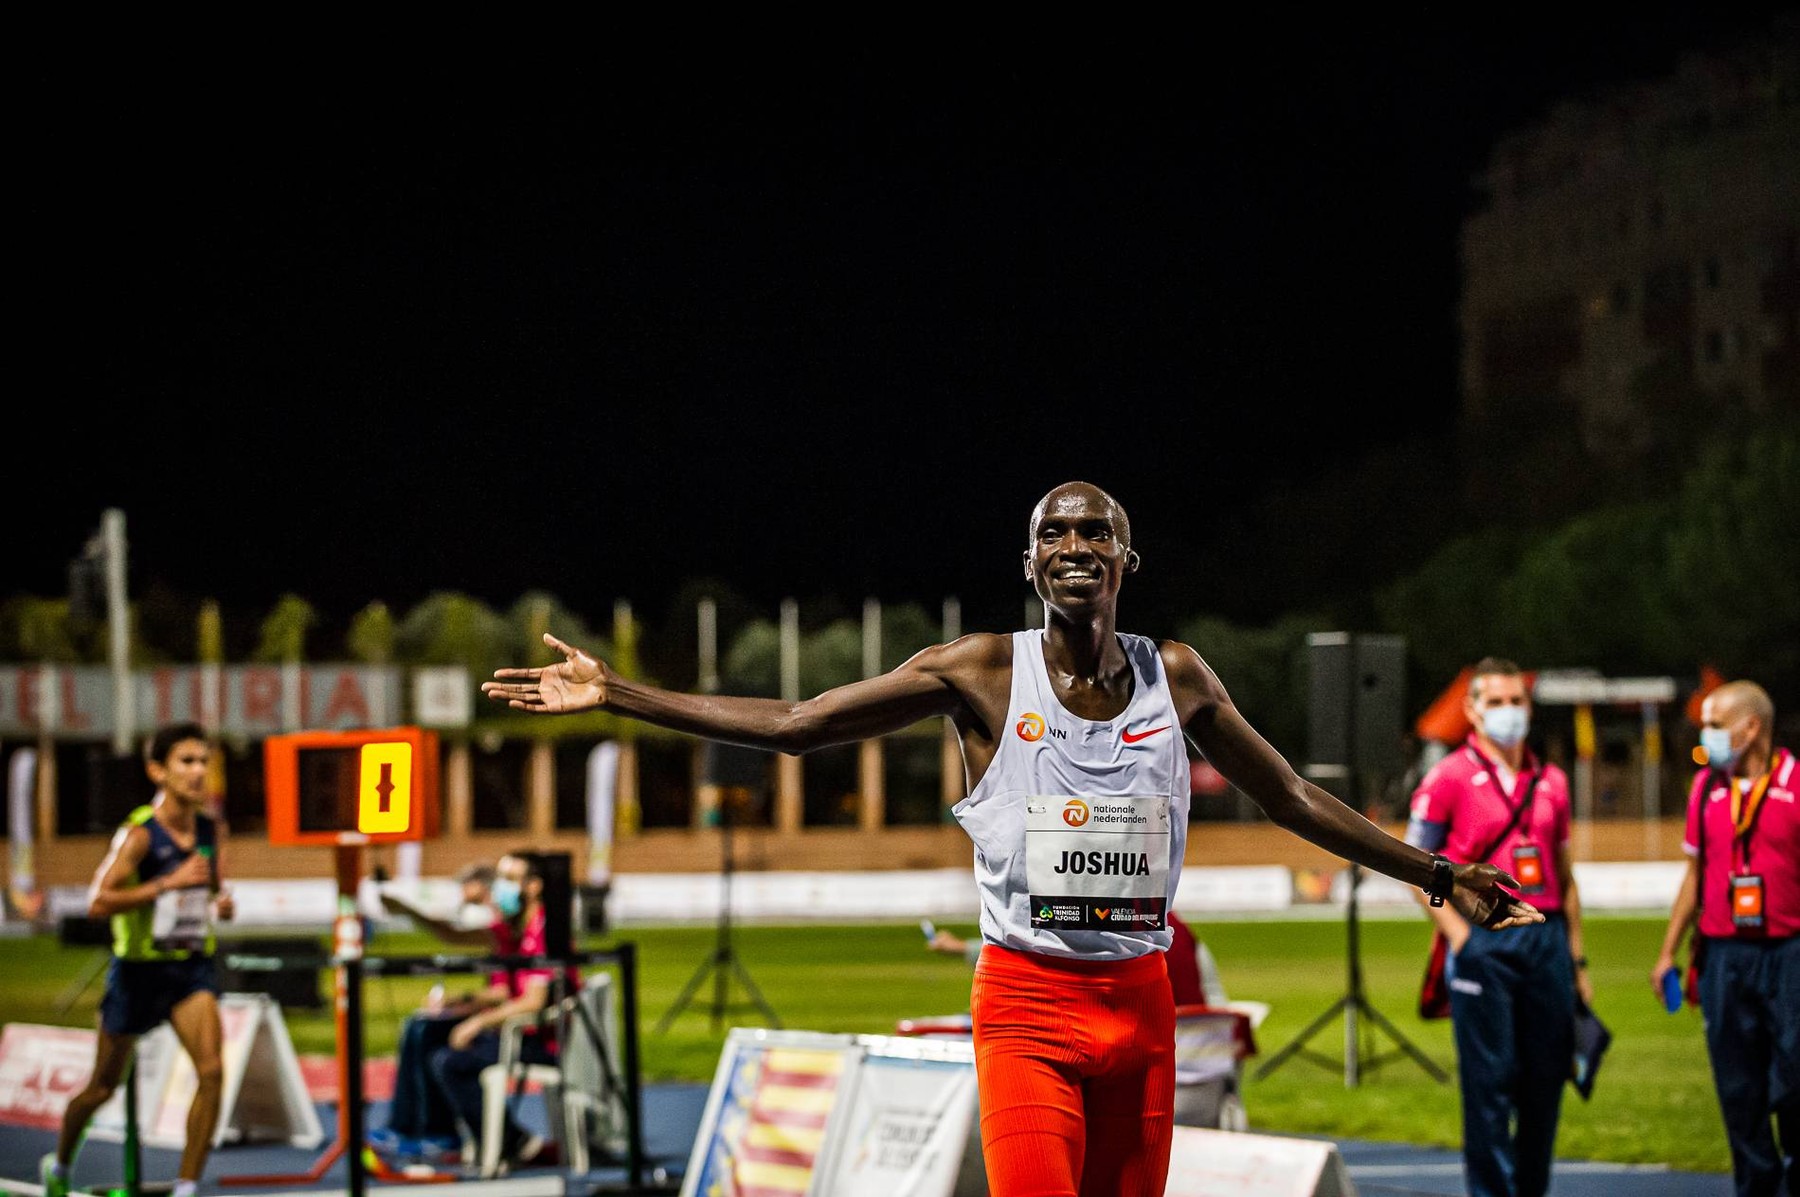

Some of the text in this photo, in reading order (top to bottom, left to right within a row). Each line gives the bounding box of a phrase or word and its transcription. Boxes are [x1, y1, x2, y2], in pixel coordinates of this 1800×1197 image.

[1048, 726, 1067, 740] NN
[1093, 805, 1136, 814] nationale
[1093, 815, 1147, 824] nederlanden
[1054, 851, 1150, 876] JOSHUA
